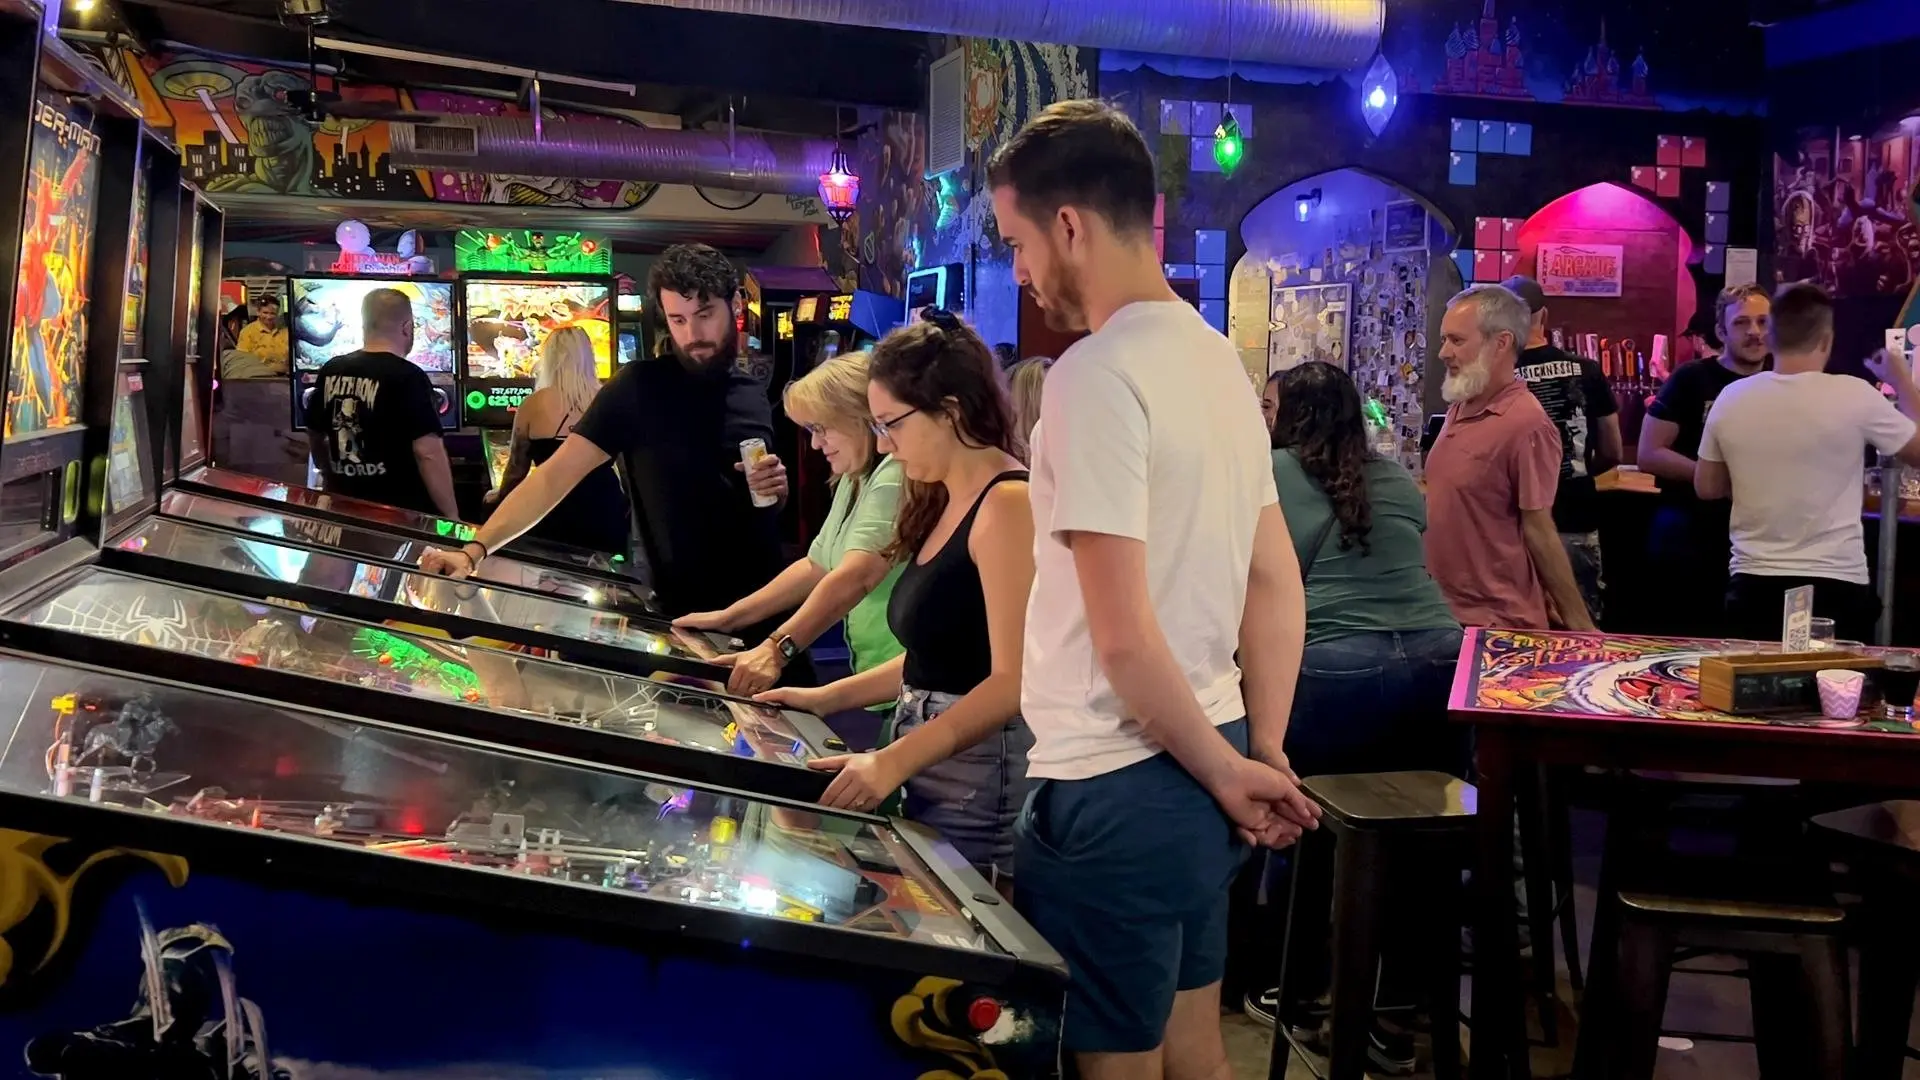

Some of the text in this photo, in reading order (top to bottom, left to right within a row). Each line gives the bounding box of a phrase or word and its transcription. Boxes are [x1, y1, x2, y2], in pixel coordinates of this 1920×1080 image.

[1523, 361, 1572, 379] SICKNESS
[324, 376, 380, 411] DEATH ROW
